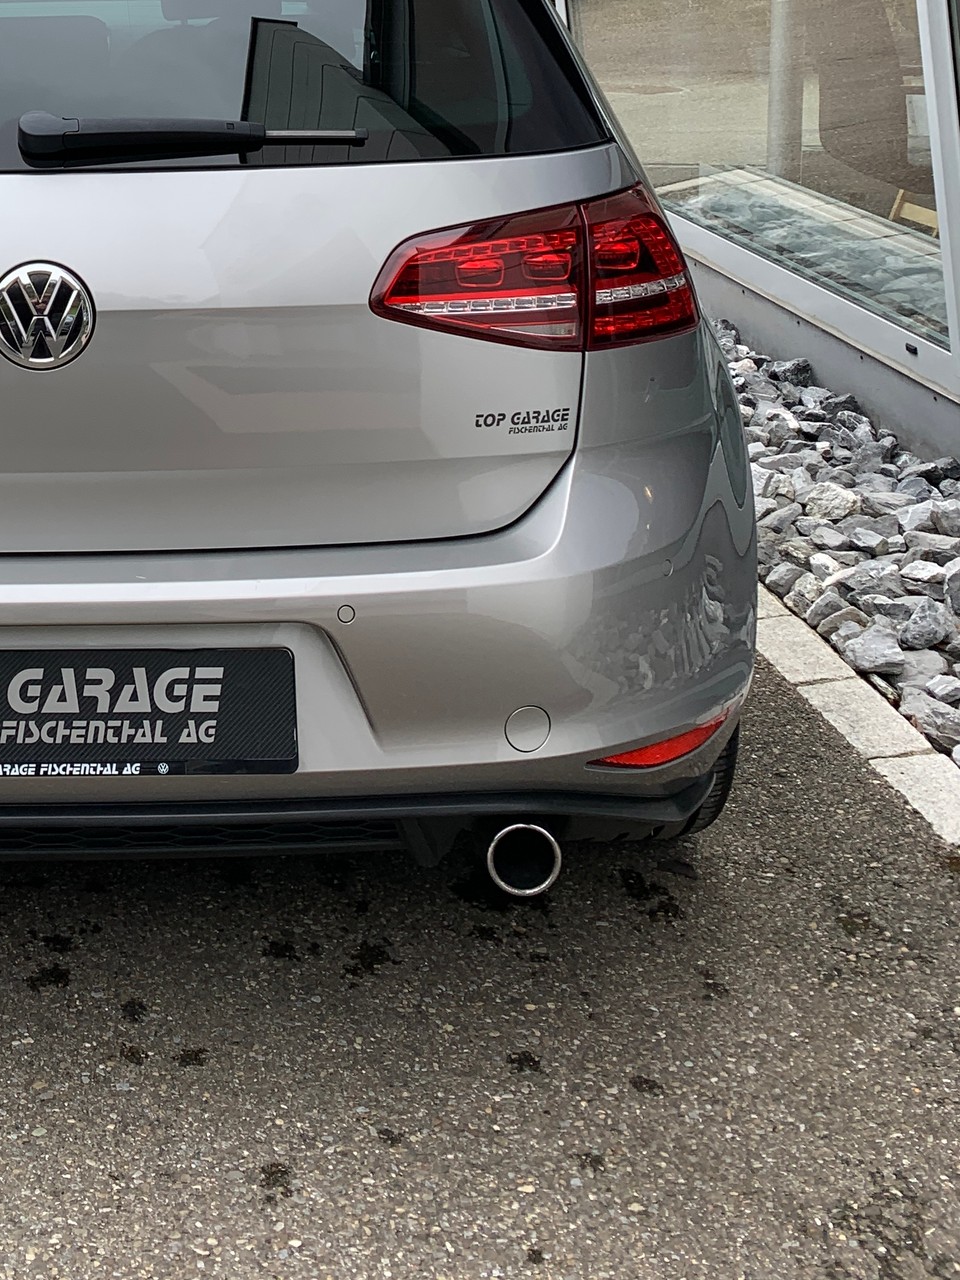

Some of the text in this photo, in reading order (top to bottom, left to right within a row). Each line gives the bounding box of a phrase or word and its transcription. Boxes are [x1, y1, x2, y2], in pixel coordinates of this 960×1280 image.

[475, 408, 570, 428] TOP GARAGE
[508, 423, 568, 434] FISCHENTHAL AG
[7, 667, 225, 714] GARAGE
[0, 720, 218, 745] FISCHENTHAL AG
[39, 763, 119, 775] FISCHENTHAL
[122, 763, 141, 775] AG
